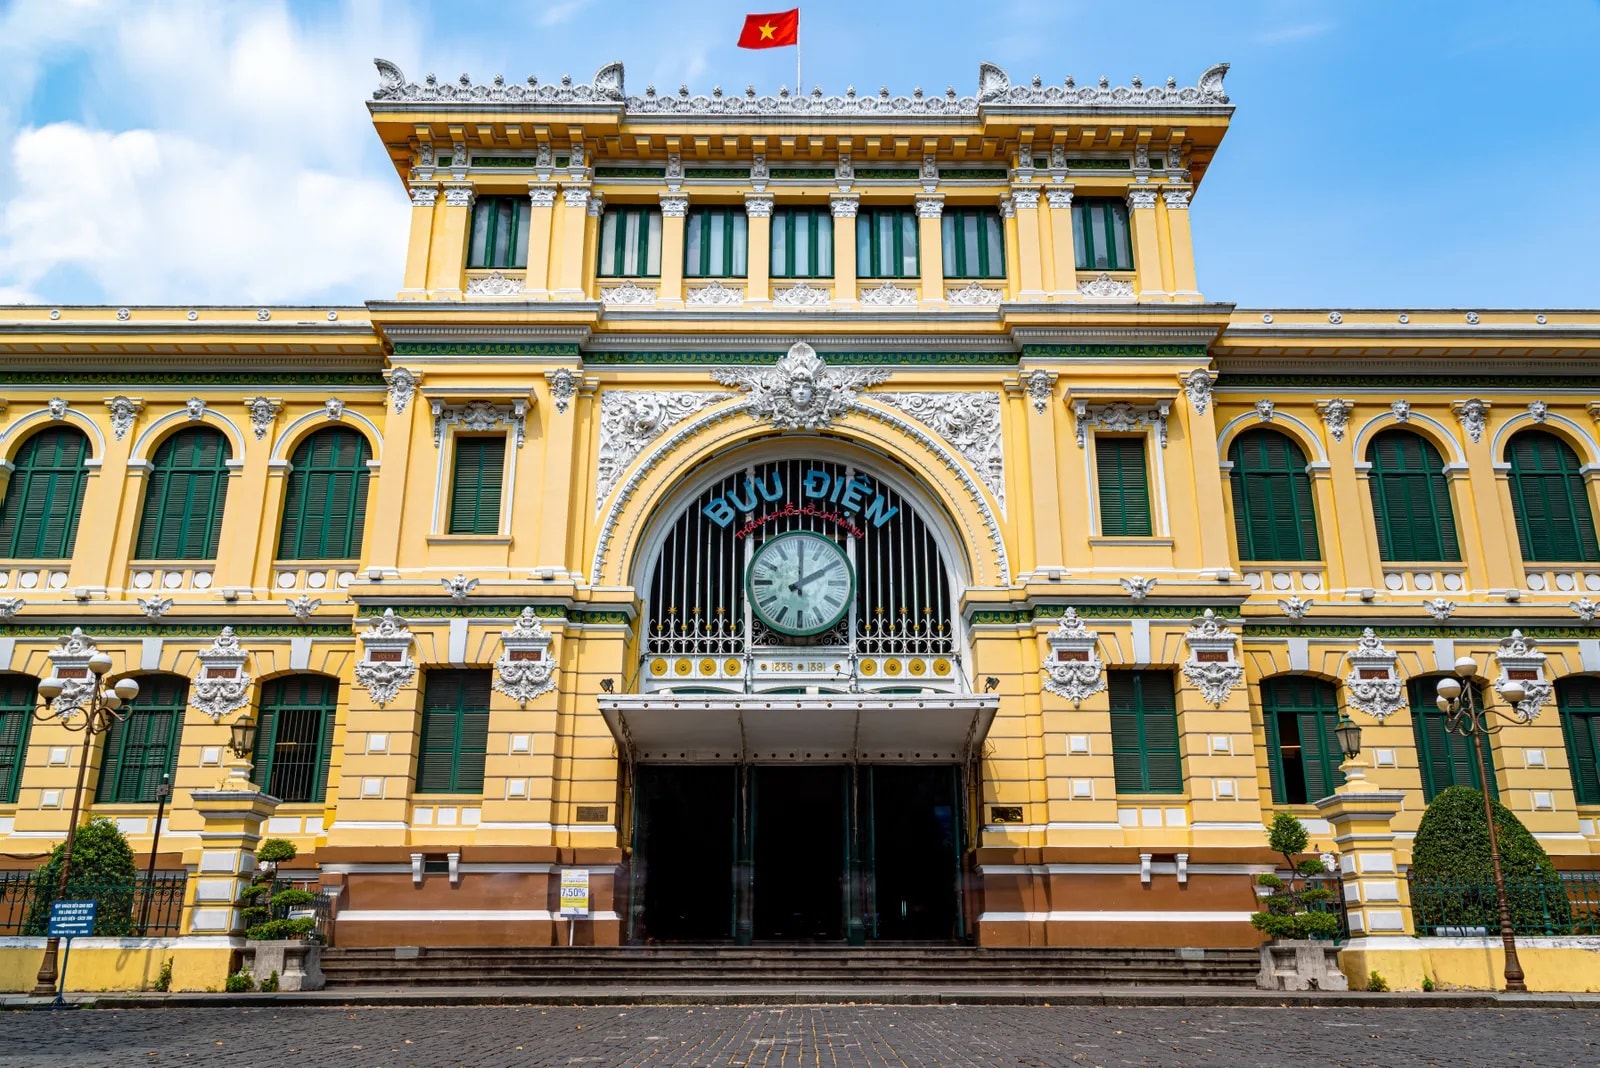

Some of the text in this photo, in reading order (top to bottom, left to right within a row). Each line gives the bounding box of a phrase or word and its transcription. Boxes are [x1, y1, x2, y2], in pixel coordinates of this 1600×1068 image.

[803, 470, 899, 528] ĐIỆN
[771, 662, 826, 672] 1886 1891
